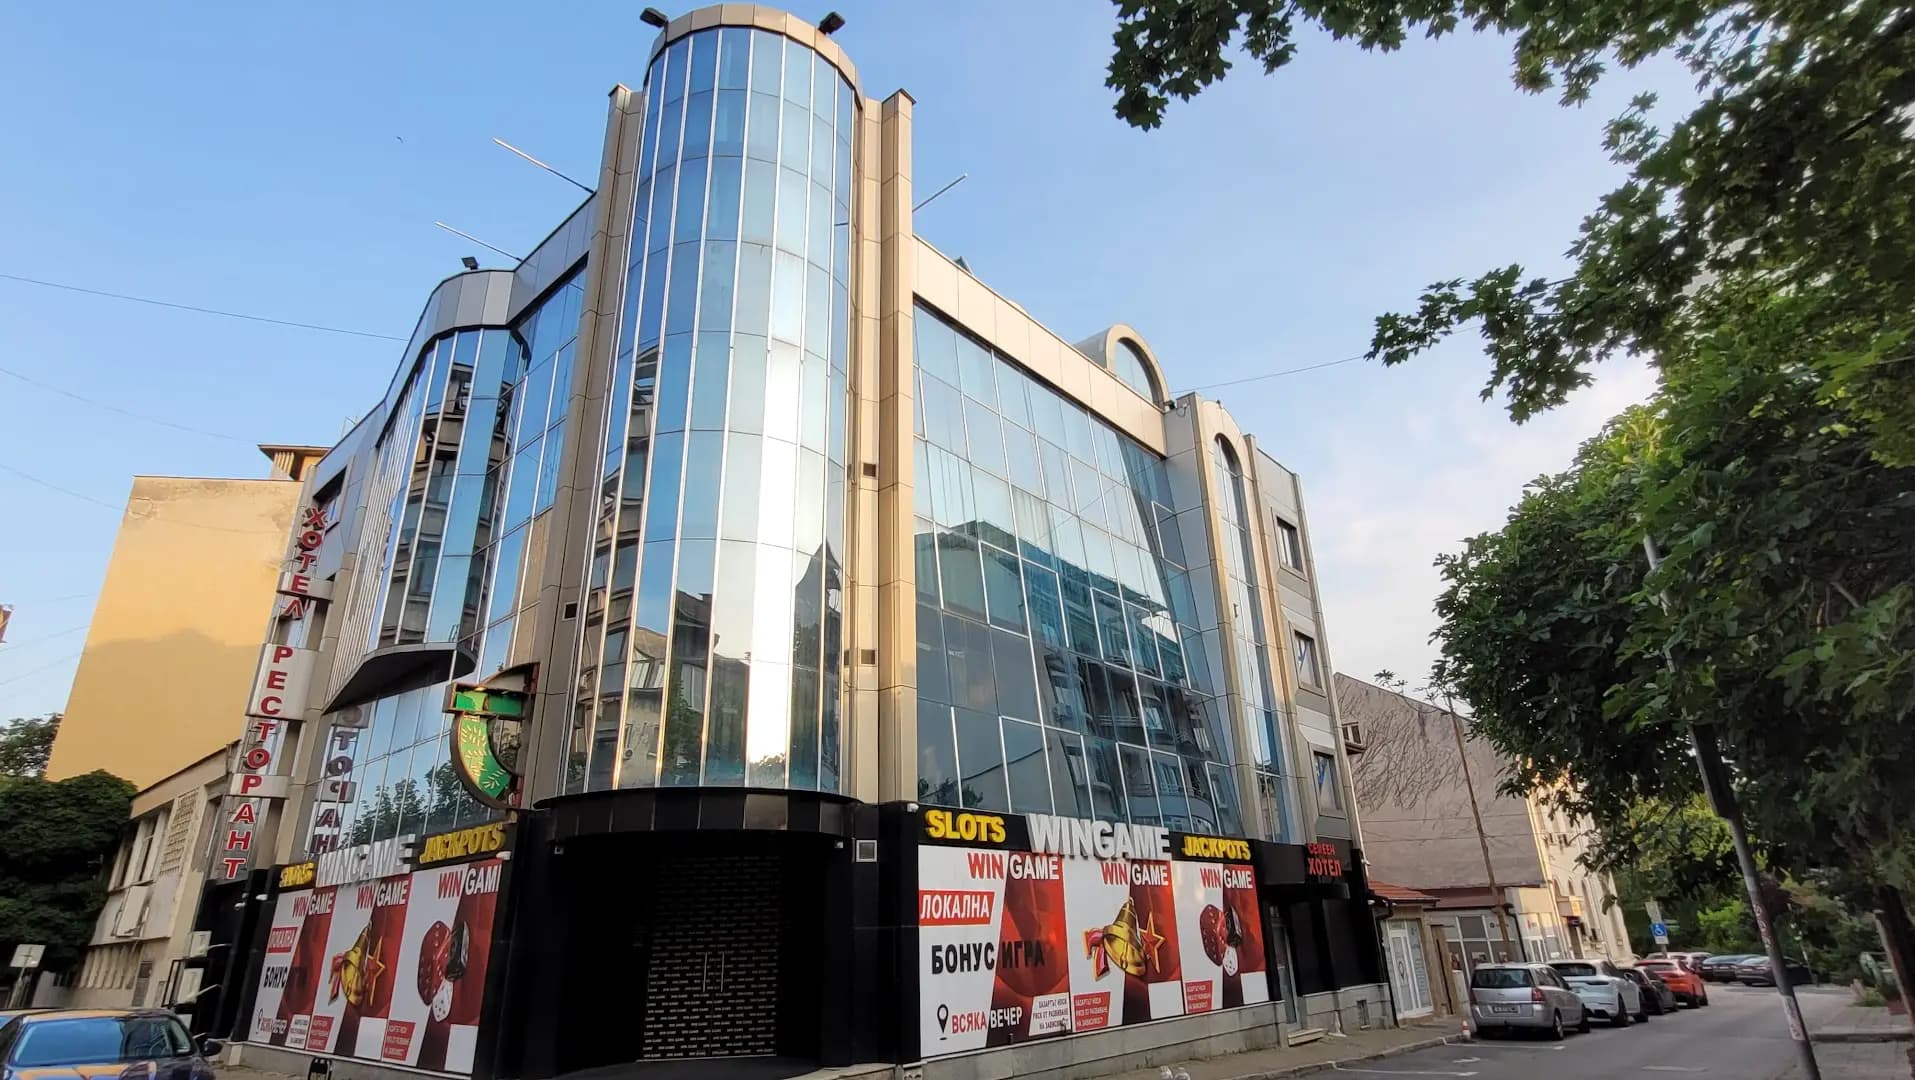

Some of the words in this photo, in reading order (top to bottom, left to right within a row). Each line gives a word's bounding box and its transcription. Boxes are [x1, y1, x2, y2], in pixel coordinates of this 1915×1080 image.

[224, 646, 293, 880] РЕСТОРАНТ
[926, 810, 1006, 843] SLOTS
[1025, 813, 1172, 861] WINGAME
[420, 823, 506, 864] JACKPOTS
[1181, 835, 1251, 860] JACKPOTS
[968, 853, 1004, 879] WIN
[1009, 854, 1059, 880] GAME
[1101, 863, 1128, 885] WIN
[1131, 864, 1168, 886] GAME
[1200, 867, 1221, 888] WIN
[1223, 868, 1253, 889] GAME
[1307, 857, 1341, 877] ХОТЕЛ
[356, 886, 374, 910] WIN
[377, 880, 408, 906] GAME
[438, 871, 460, 899] WIN
[308, 893, 334, 915] GAME
[920, 894, 990, 919] ЛОКАЛНА
[931, 942, 995, 975] БОНУС
[1001, 940, 1046, 968] ИГРА
[952, 1012, 987, 1033] ВСЯКА
[990, 1007, 1023, 1028] ВЕЧЕР
